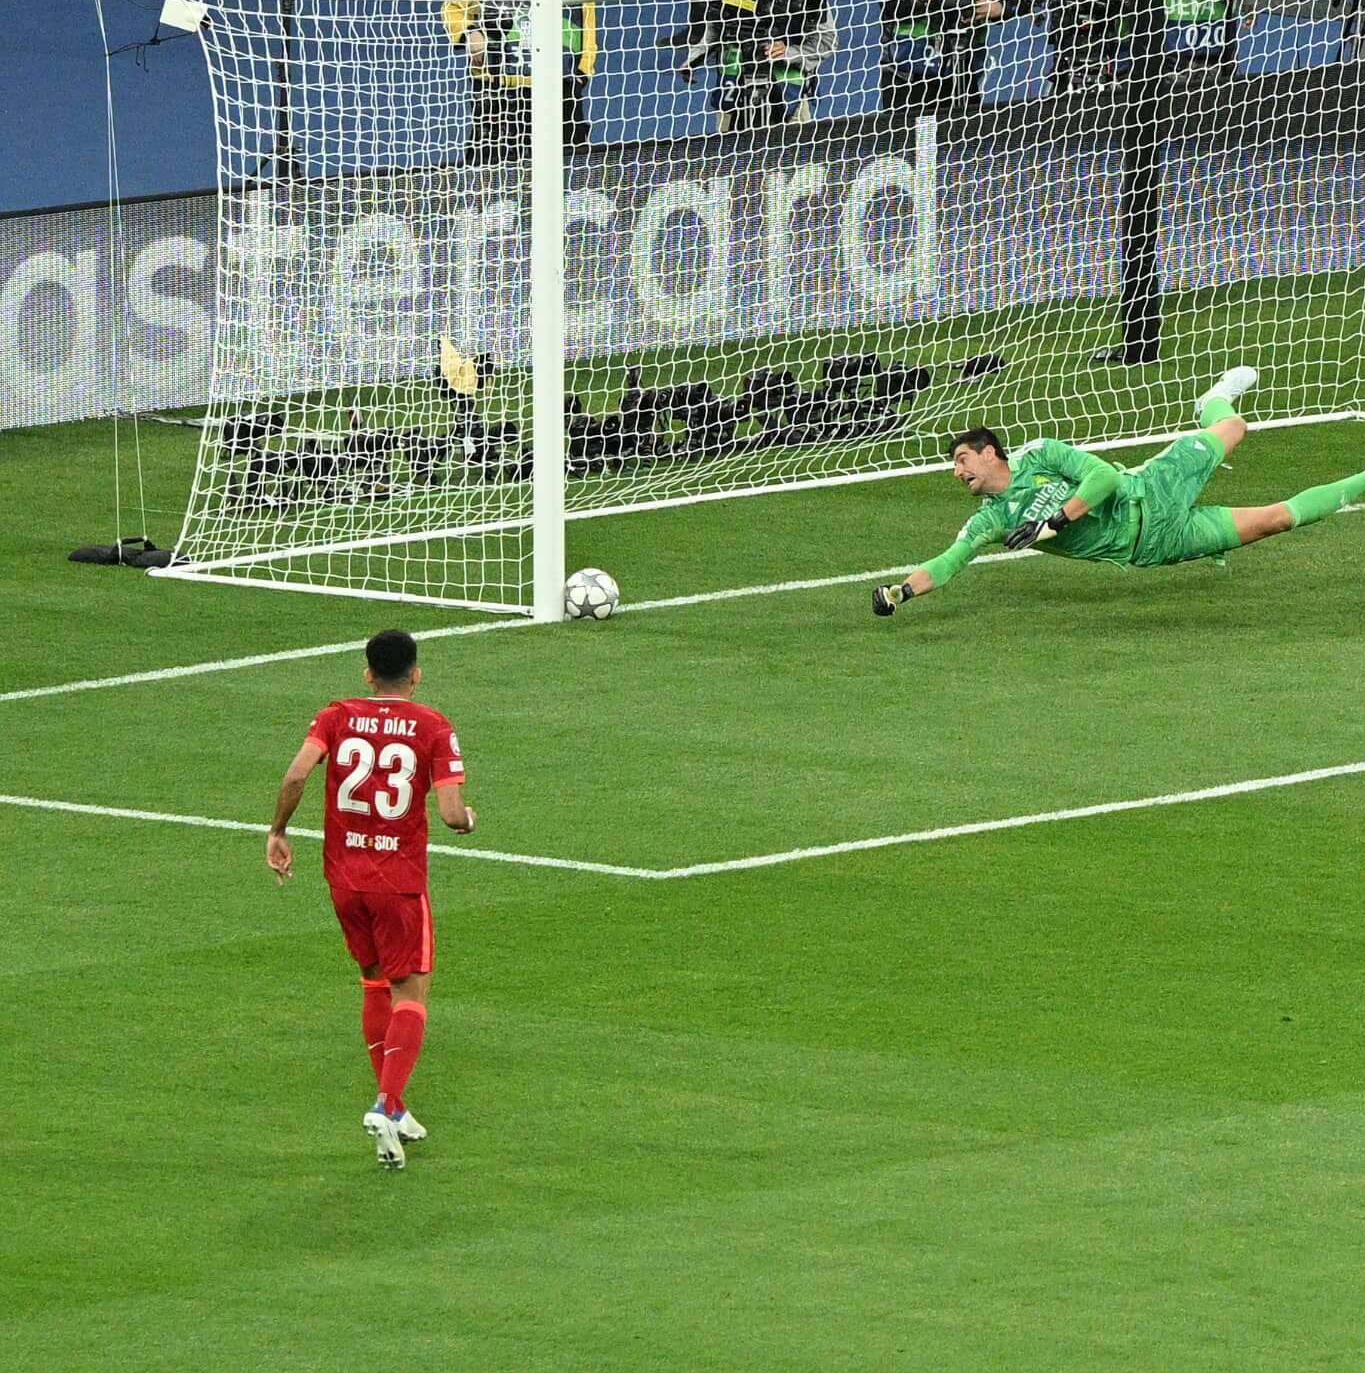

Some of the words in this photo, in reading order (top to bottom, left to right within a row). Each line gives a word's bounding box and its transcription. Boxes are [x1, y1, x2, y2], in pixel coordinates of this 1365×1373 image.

[383, 716, 418, 738] DÍAZ
[336, 738, 418, 821] 23
[346, 831, 367, 849] SIDE
[374, 834, 401, 852] SIDE
